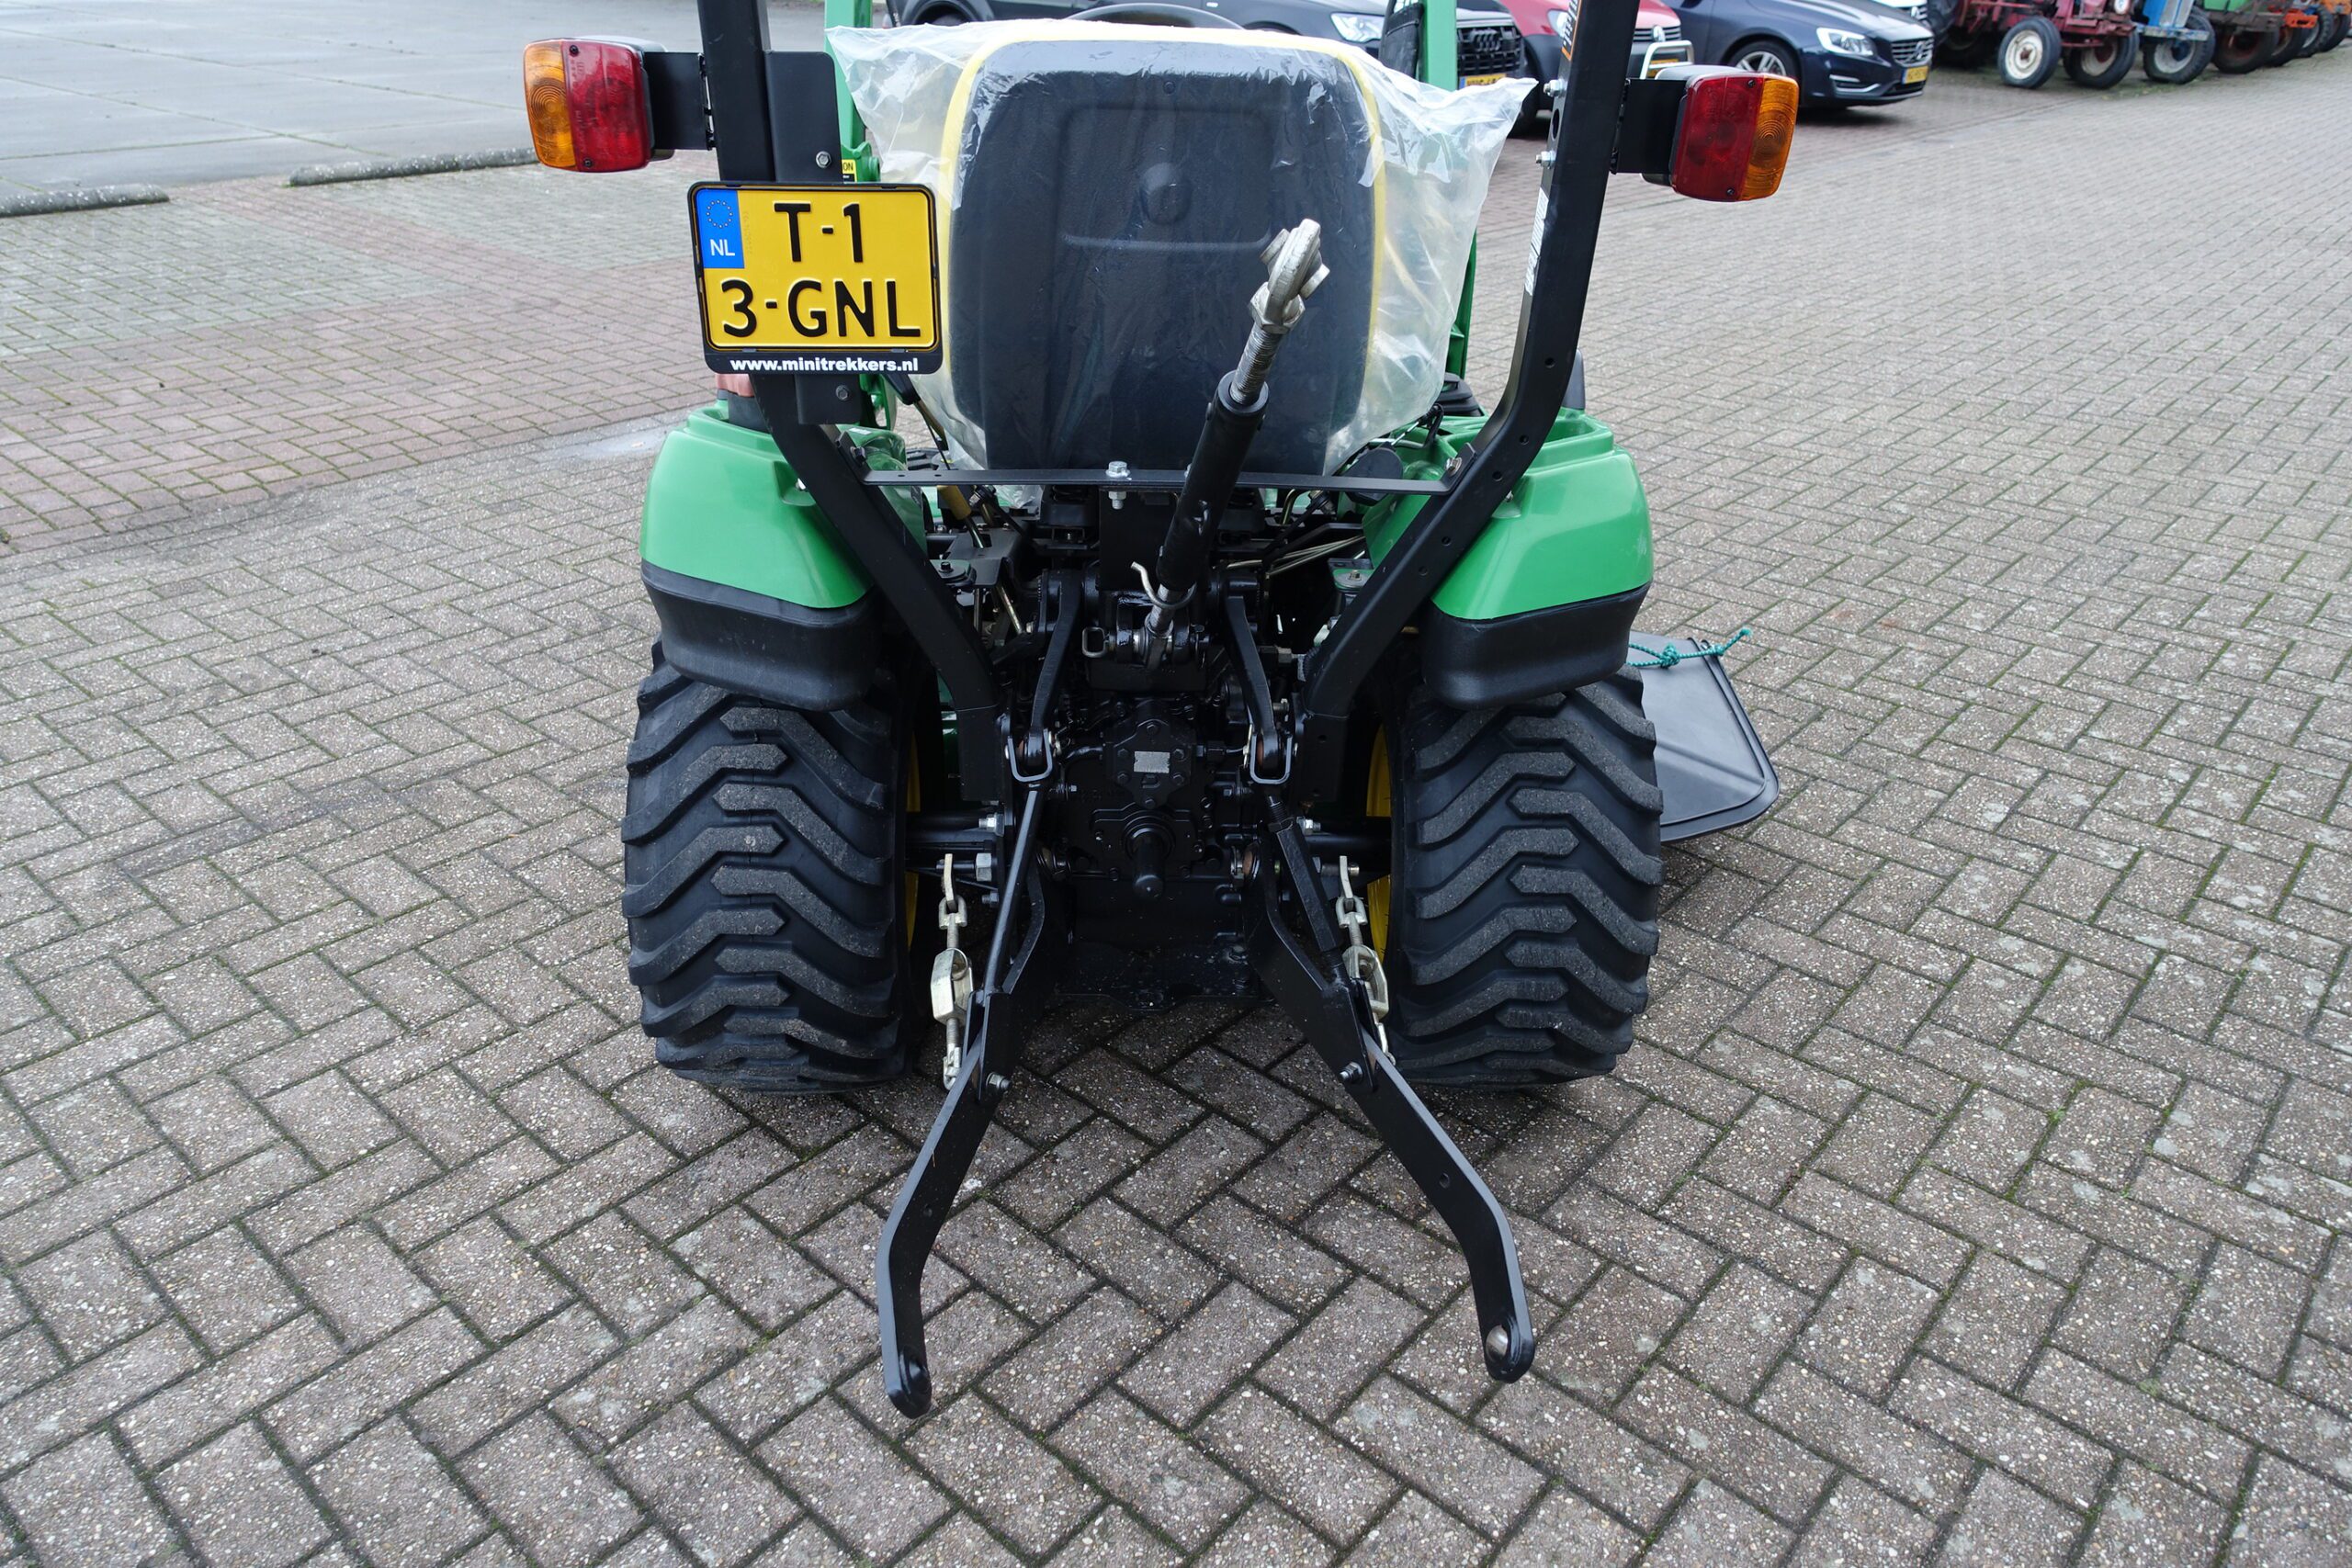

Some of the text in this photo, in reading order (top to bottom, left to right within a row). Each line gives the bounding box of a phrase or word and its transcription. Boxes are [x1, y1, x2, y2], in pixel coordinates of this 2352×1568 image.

[710, 239, 735, 257] NL
[774, 201, 864, 263] T-1
[720, 277, 922, 337] 3-GNL
[729, 357, 919, 372] www.minitrekkers.nl
